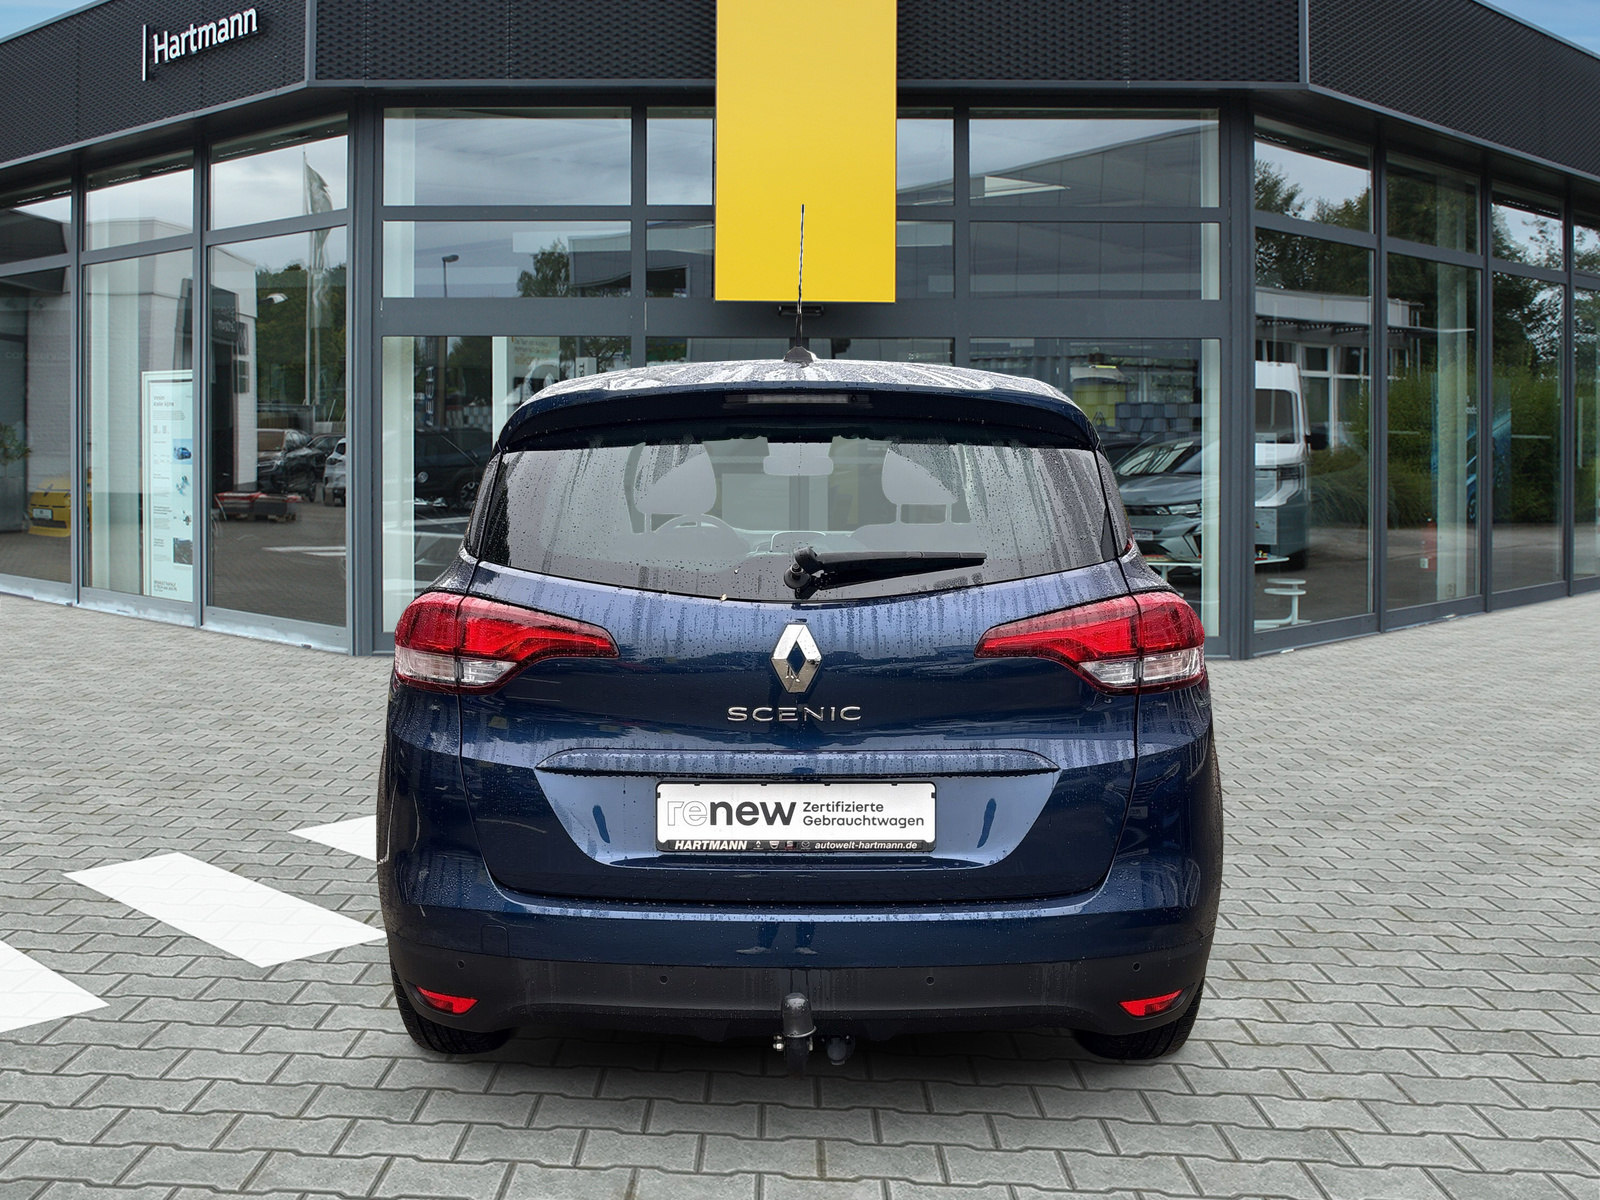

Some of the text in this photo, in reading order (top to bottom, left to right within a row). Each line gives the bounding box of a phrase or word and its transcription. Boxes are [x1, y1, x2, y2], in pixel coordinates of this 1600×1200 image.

[153, 8, 257, 64] Hartmann
[727, 706, 862, 722] SCENIC
[667, 801, 797, 826] renew
[803, 801, 884, 812] Zertifizierte
[803, 815, 925, 829] Gebrauchtwagen
[674, 840, 748, 850] HARTMANN
[814, 841, 918, 850] autowelt-hartmann.de
